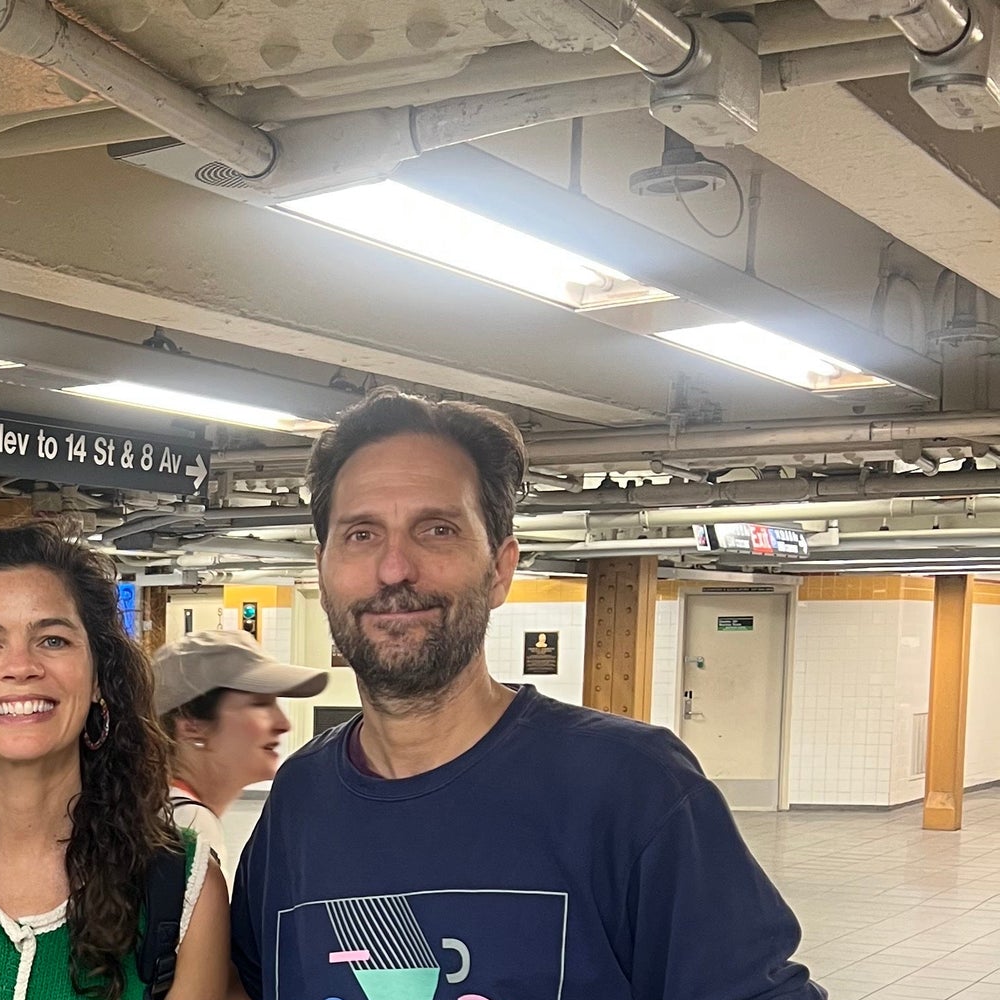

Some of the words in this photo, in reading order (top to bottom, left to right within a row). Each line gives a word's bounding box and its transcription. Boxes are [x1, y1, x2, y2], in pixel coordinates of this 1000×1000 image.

[37, 428, 58, 460] to
[65, 433, 87, 463] 14
[93, 436, 116, 467] St
[120, 439, 134, 469] &
[140, 443, 154, 471] 8
[158, 446, 182, 474] Av
